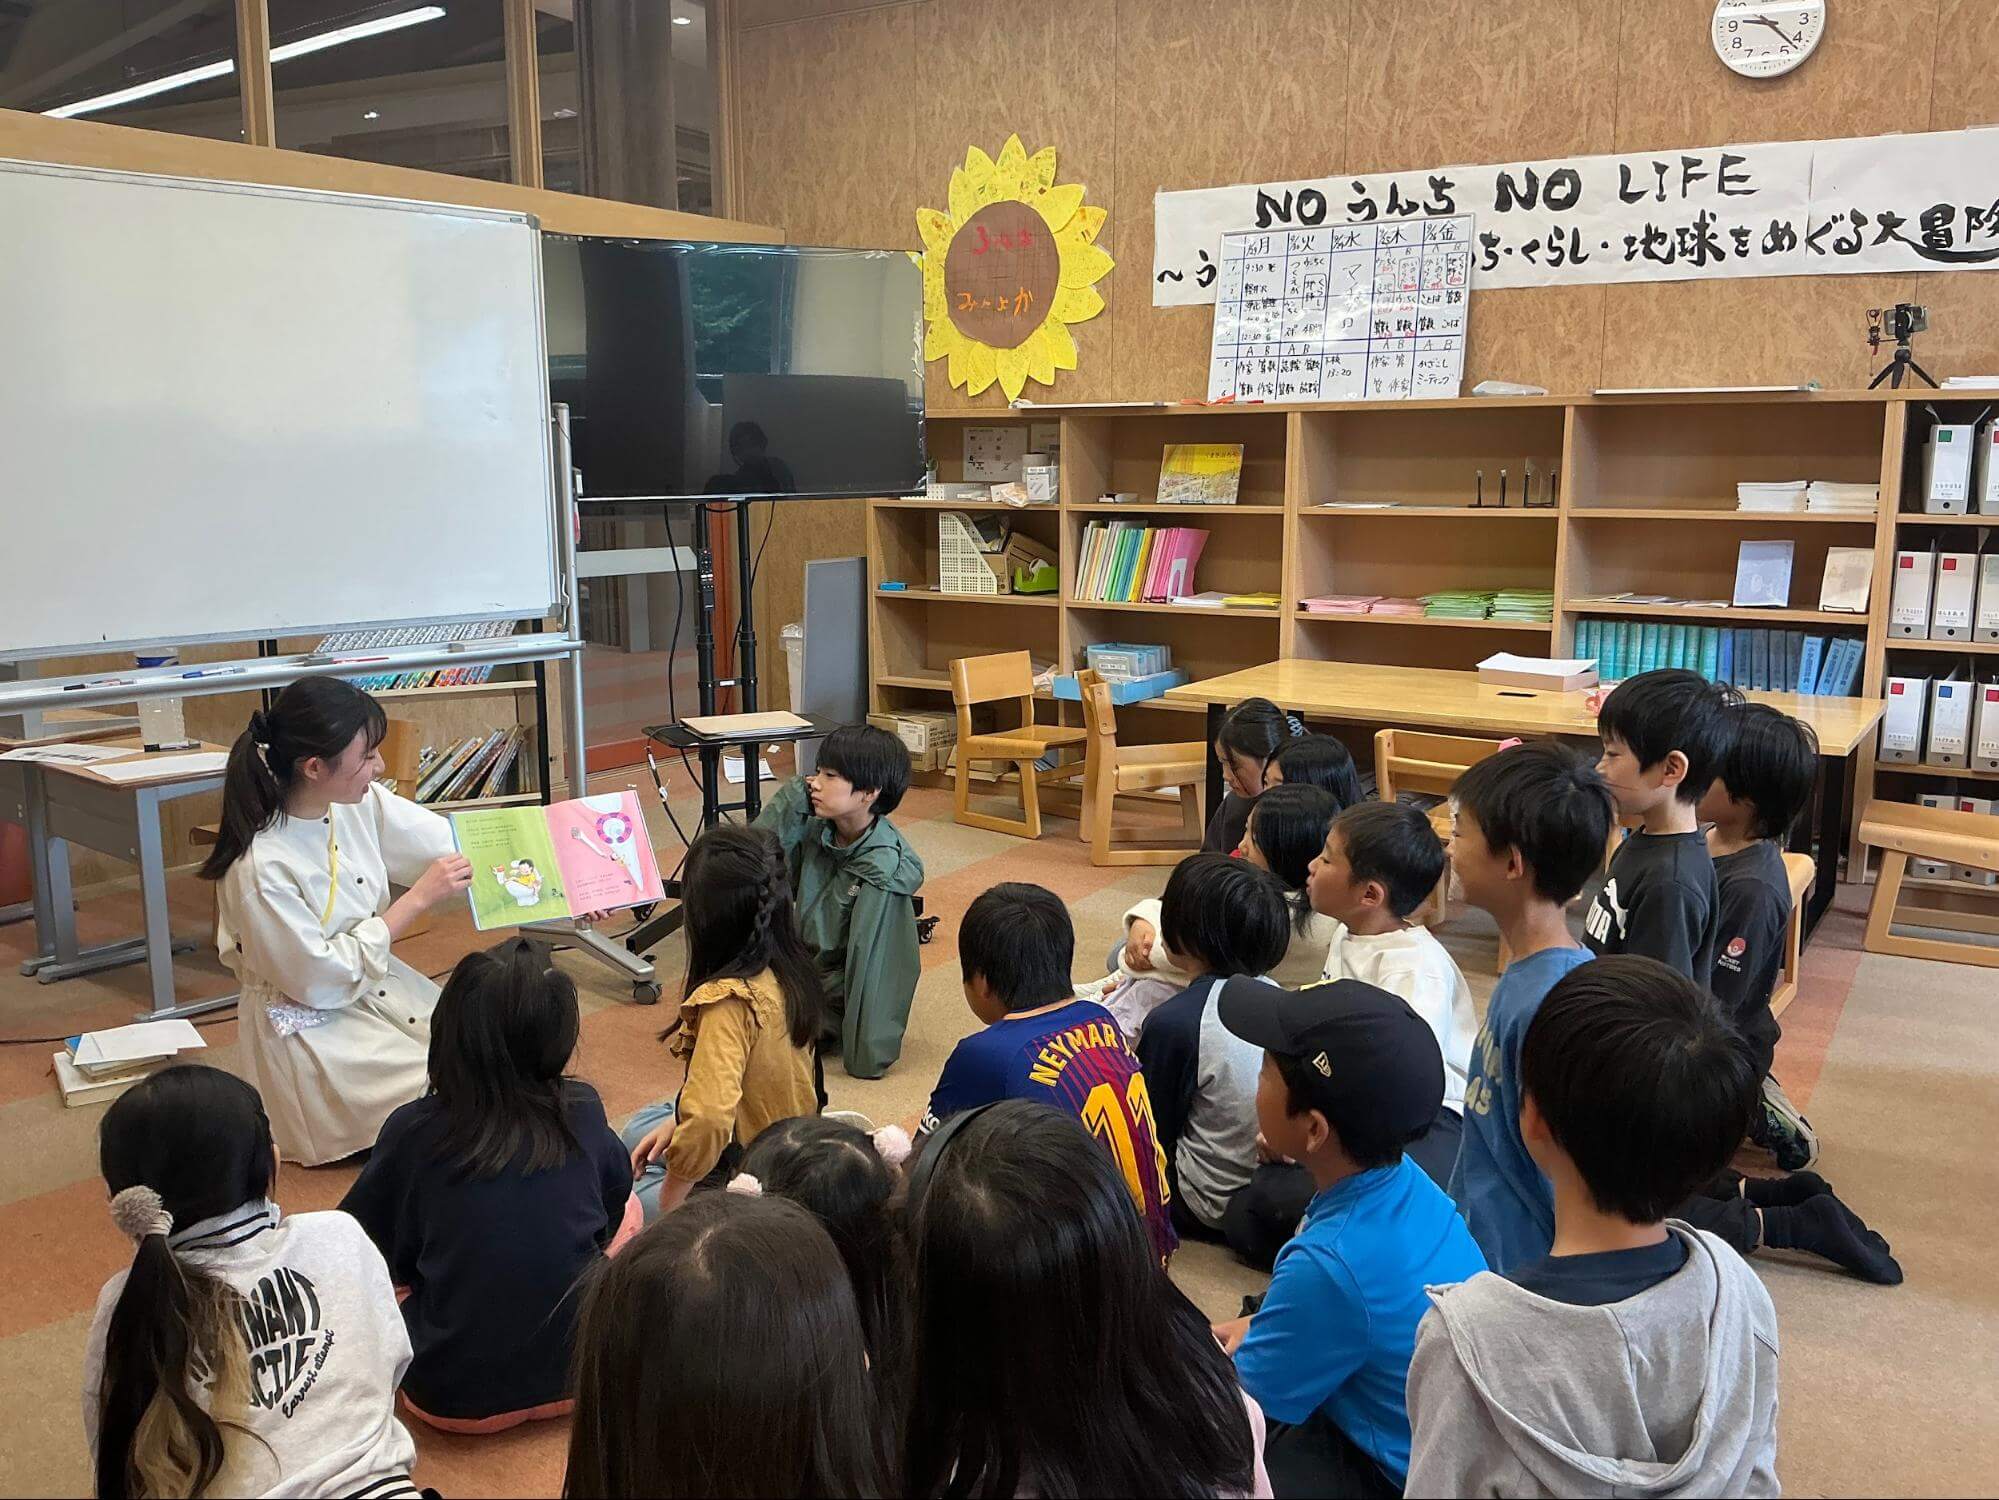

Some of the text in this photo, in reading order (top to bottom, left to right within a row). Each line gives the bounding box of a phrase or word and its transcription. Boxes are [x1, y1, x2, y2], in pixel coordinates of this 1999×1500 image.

[1799, 13, 1809, 25] 3
[1728, 20, 1738, 33] 9
[1732, 37, 1742, 49] 8
[1793, 31, 1802, 43] 4
[1744, 49, 1753, 58] 7
[1780, 45, 1790, 55] 5
[1255, 153, 1760, 228] NO うんち NO LIFE
[1247, 345, 1254, 357] A
[1288, 343, 1295, 355] A
[1423, 339, 1432, 351] A
[1029, 1023, 1119, 1087] NEYMAR
[1081, 1071, 1171, 1214] 11
